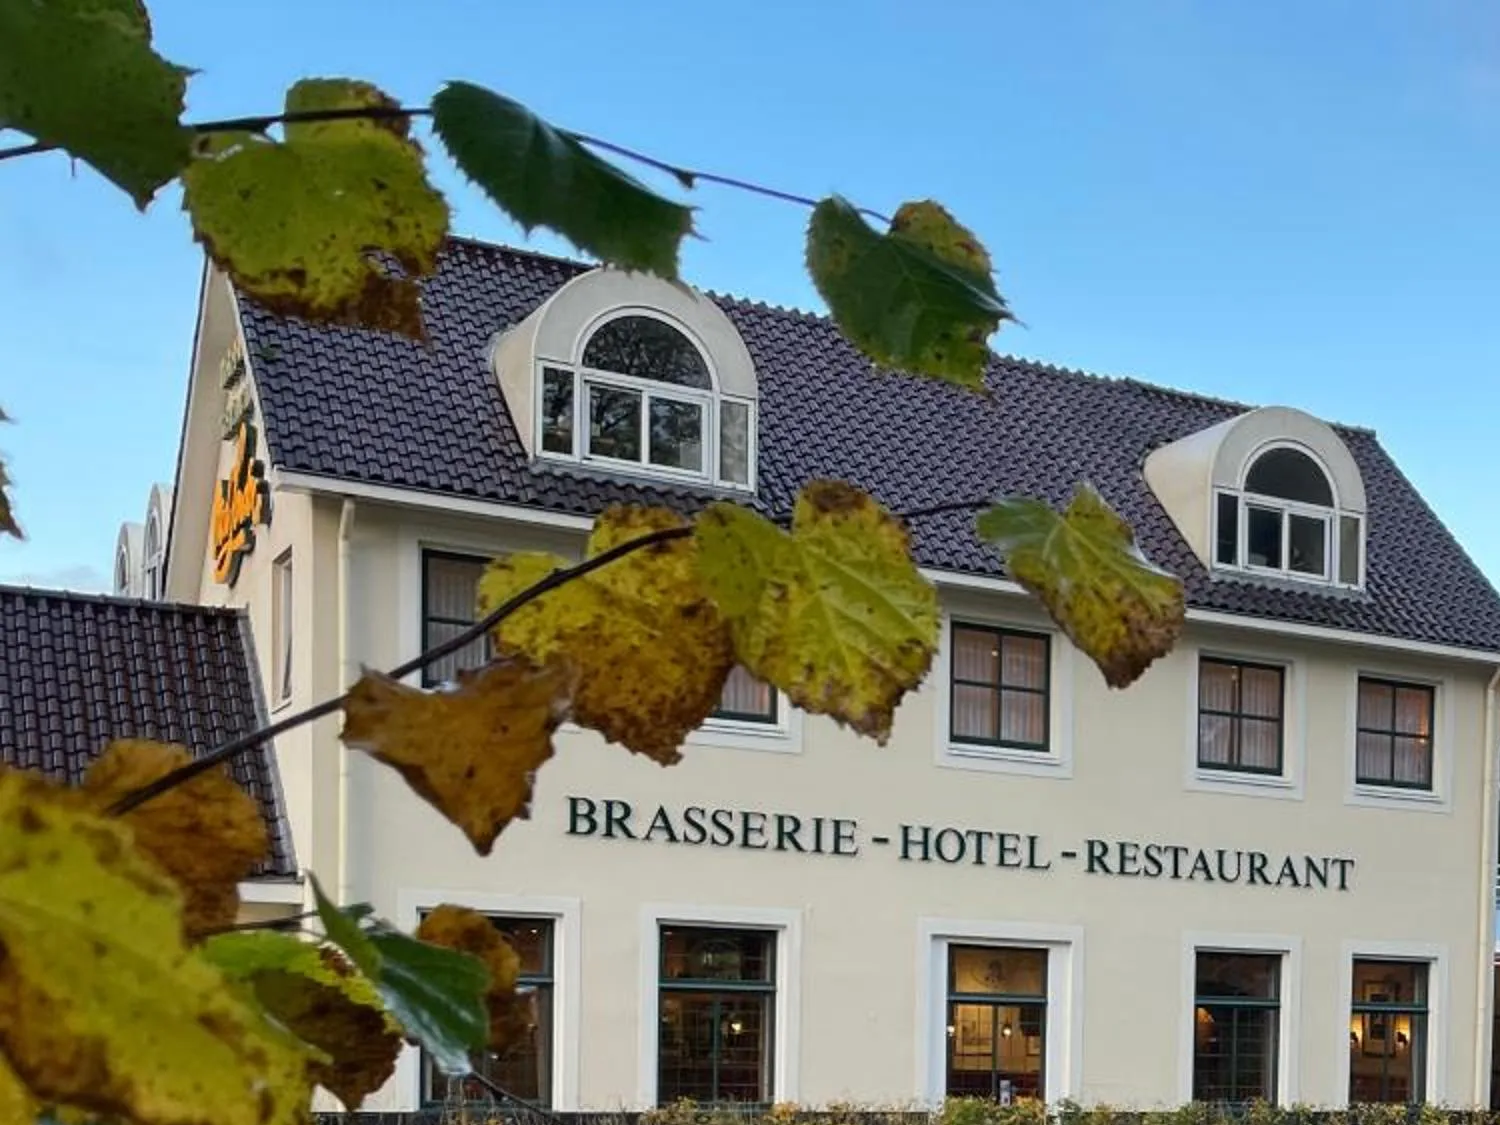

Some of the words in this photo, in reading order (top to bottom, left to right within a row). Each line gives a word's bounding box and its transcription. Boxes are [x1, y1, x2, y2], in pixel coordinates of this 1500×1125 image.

[565, 796, 859, 857] BRASSERIE
[899, 824, 1052, 871] HOTEL
[1084, 838, 1356, 892] RESTAURANT
